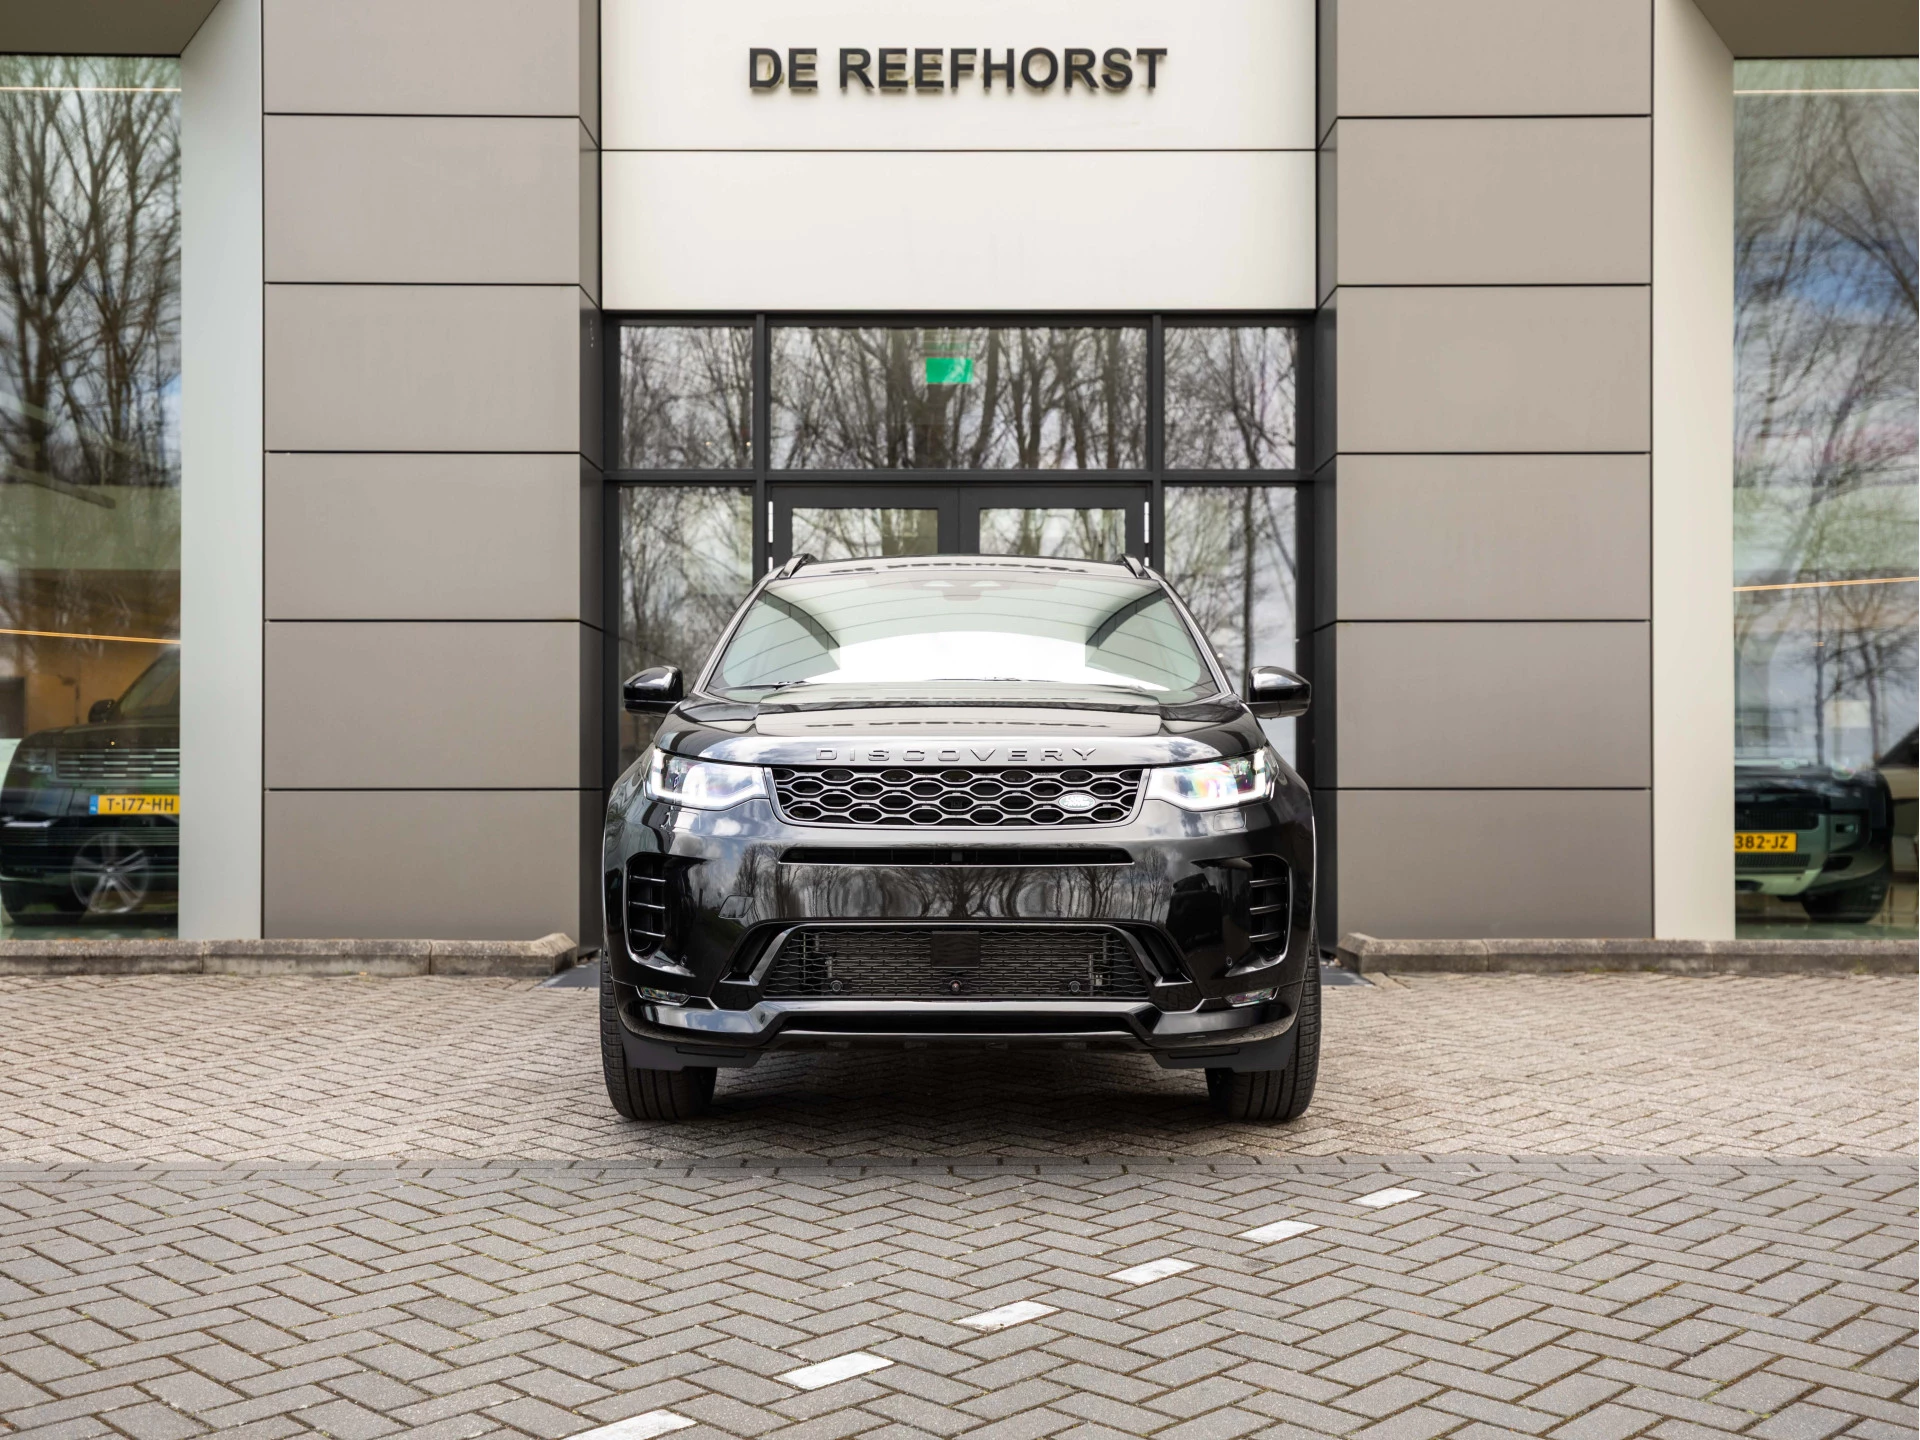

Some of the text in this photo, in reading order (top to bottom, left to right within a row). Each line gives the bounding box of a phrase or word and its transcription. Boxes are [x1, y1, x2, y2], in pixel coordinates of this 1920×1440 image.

[749, 47, 1167, 89] DE REEFHORST
[816, 748, 1096, 762] DISCOVERY
[106, 797, 175, 812] T-177-HH
